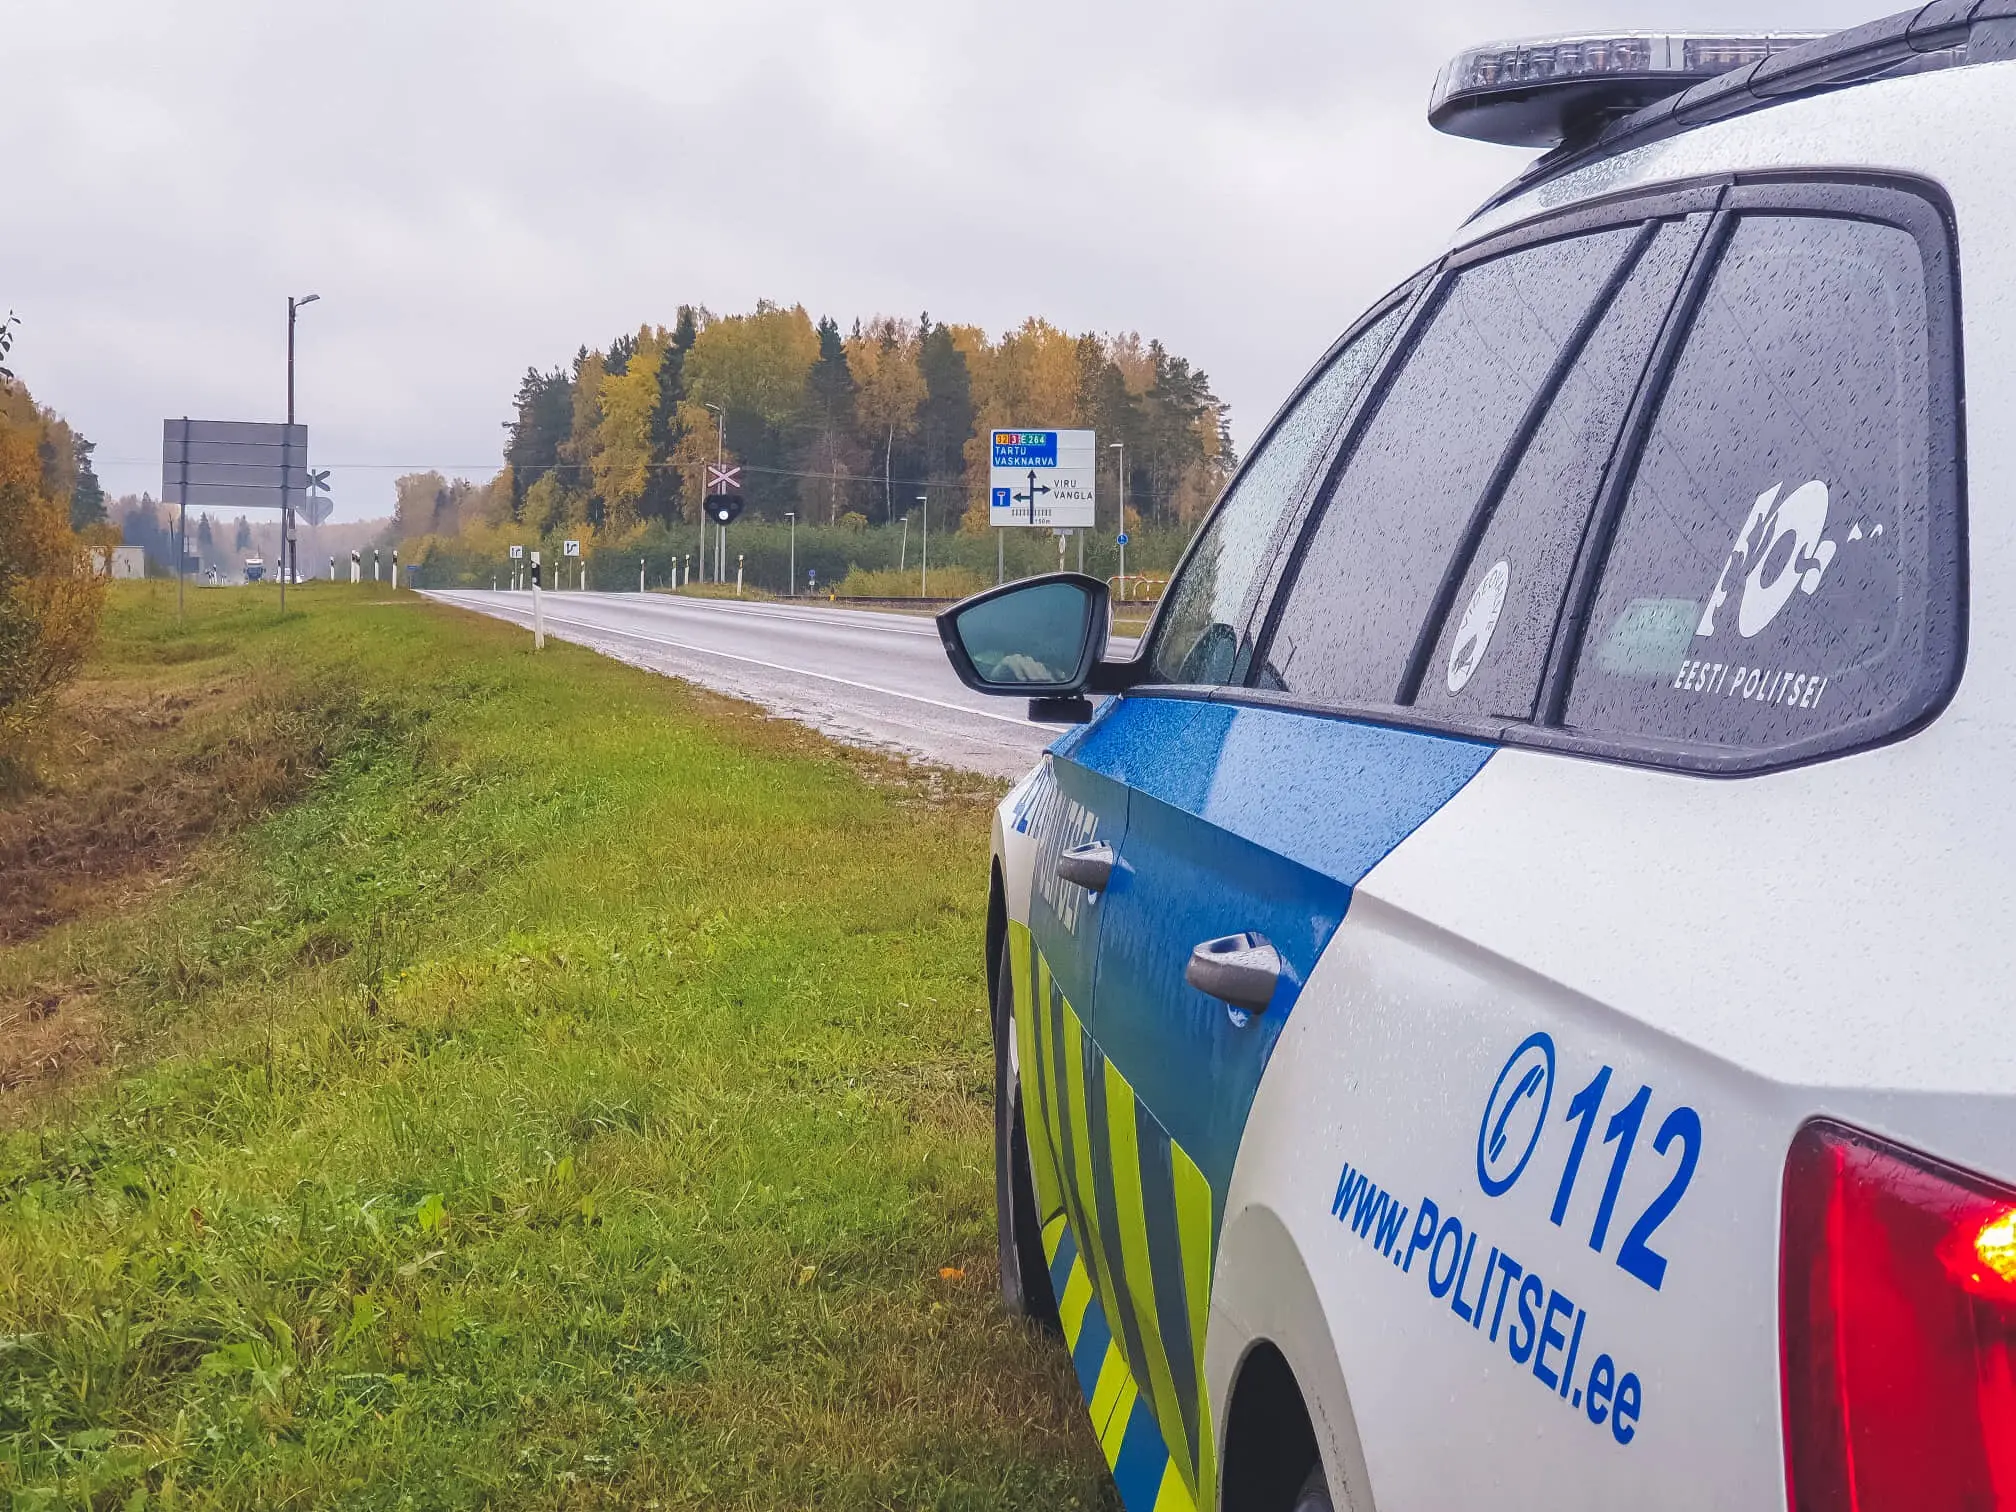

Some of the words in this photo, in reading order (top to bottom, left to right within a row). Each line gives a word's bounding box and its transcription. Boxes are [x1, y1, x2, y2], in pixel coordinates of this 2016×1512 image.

[1011, 435, 1018, 444] 3
[995, 446, 1027, 455] TARTU
[995, 457, 1054, 465] VASKNARVA
[1054, 479, 1077, 488] VIRU
[1054, 491, 1093, 500] VANGLA
[1674, 660, 1729, 694] EESTI
[1729, 666, 1828, 709] POLITSEI
[1550, 1065, 1702, 1292] 112
[1331, 1162, 1642, 1446] www.POLITSEI.ee
